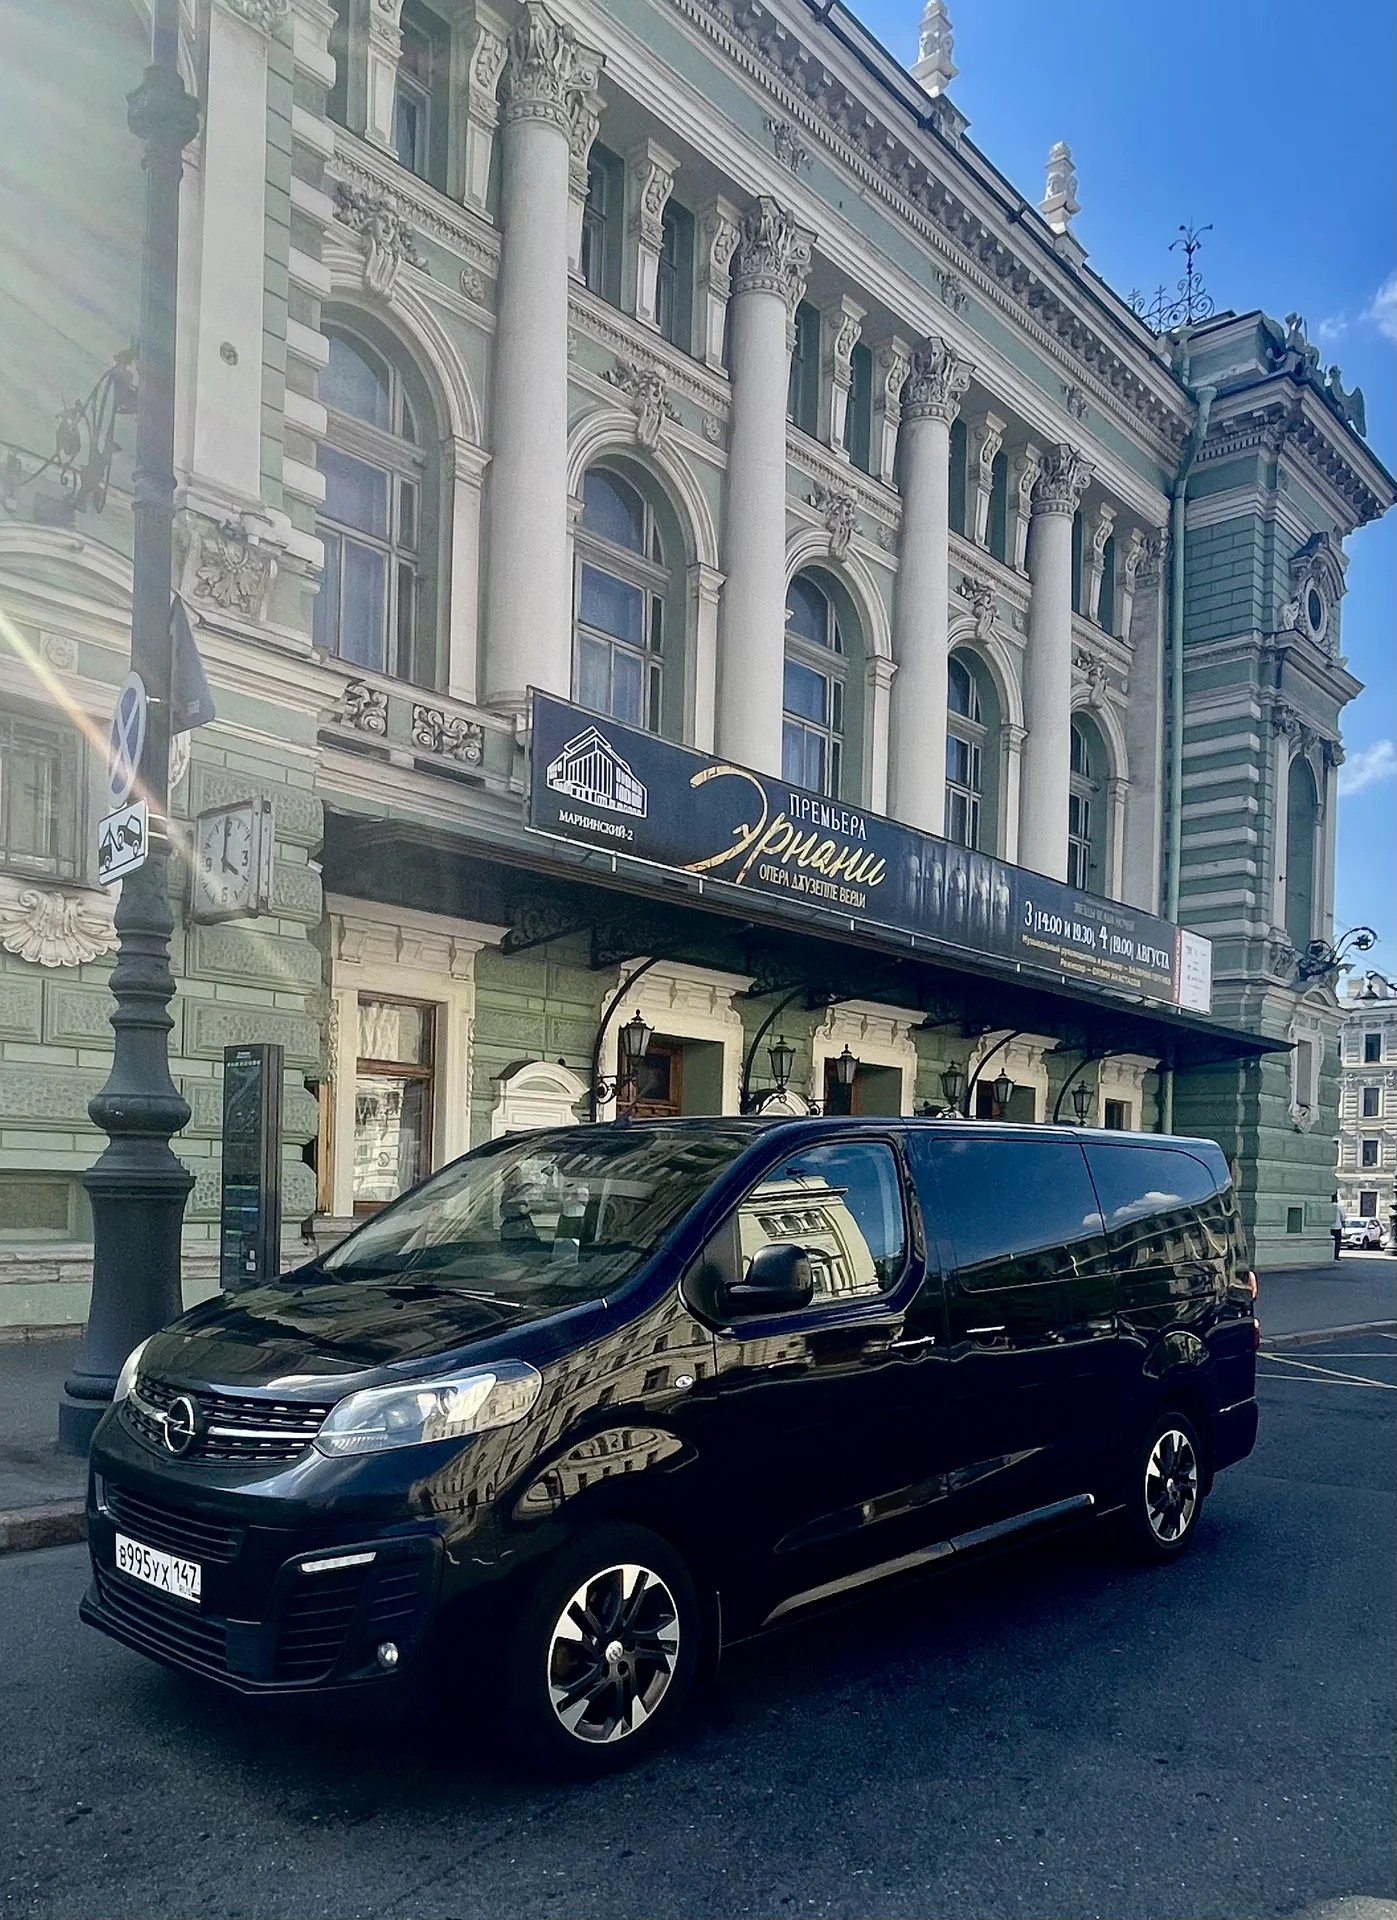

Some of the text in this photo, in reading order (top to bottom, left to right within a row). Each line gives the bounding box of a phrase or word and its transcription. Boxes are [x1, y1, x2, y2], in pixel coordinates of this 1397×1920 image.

[558, 809, 634, 841] МАРИИНСКИЙ-2
[681, 765, 886, 887] Эрнани
[789, 793, 867, 841] ПРЕМЬЕРА
[759, 863, 866, 908] ОПЕРА ДЖУЗЕППЕ ВЕРДИ
[1135, 943, 1170, 970] АВГУСТА
[173, 1560, 197, 1589] 147
